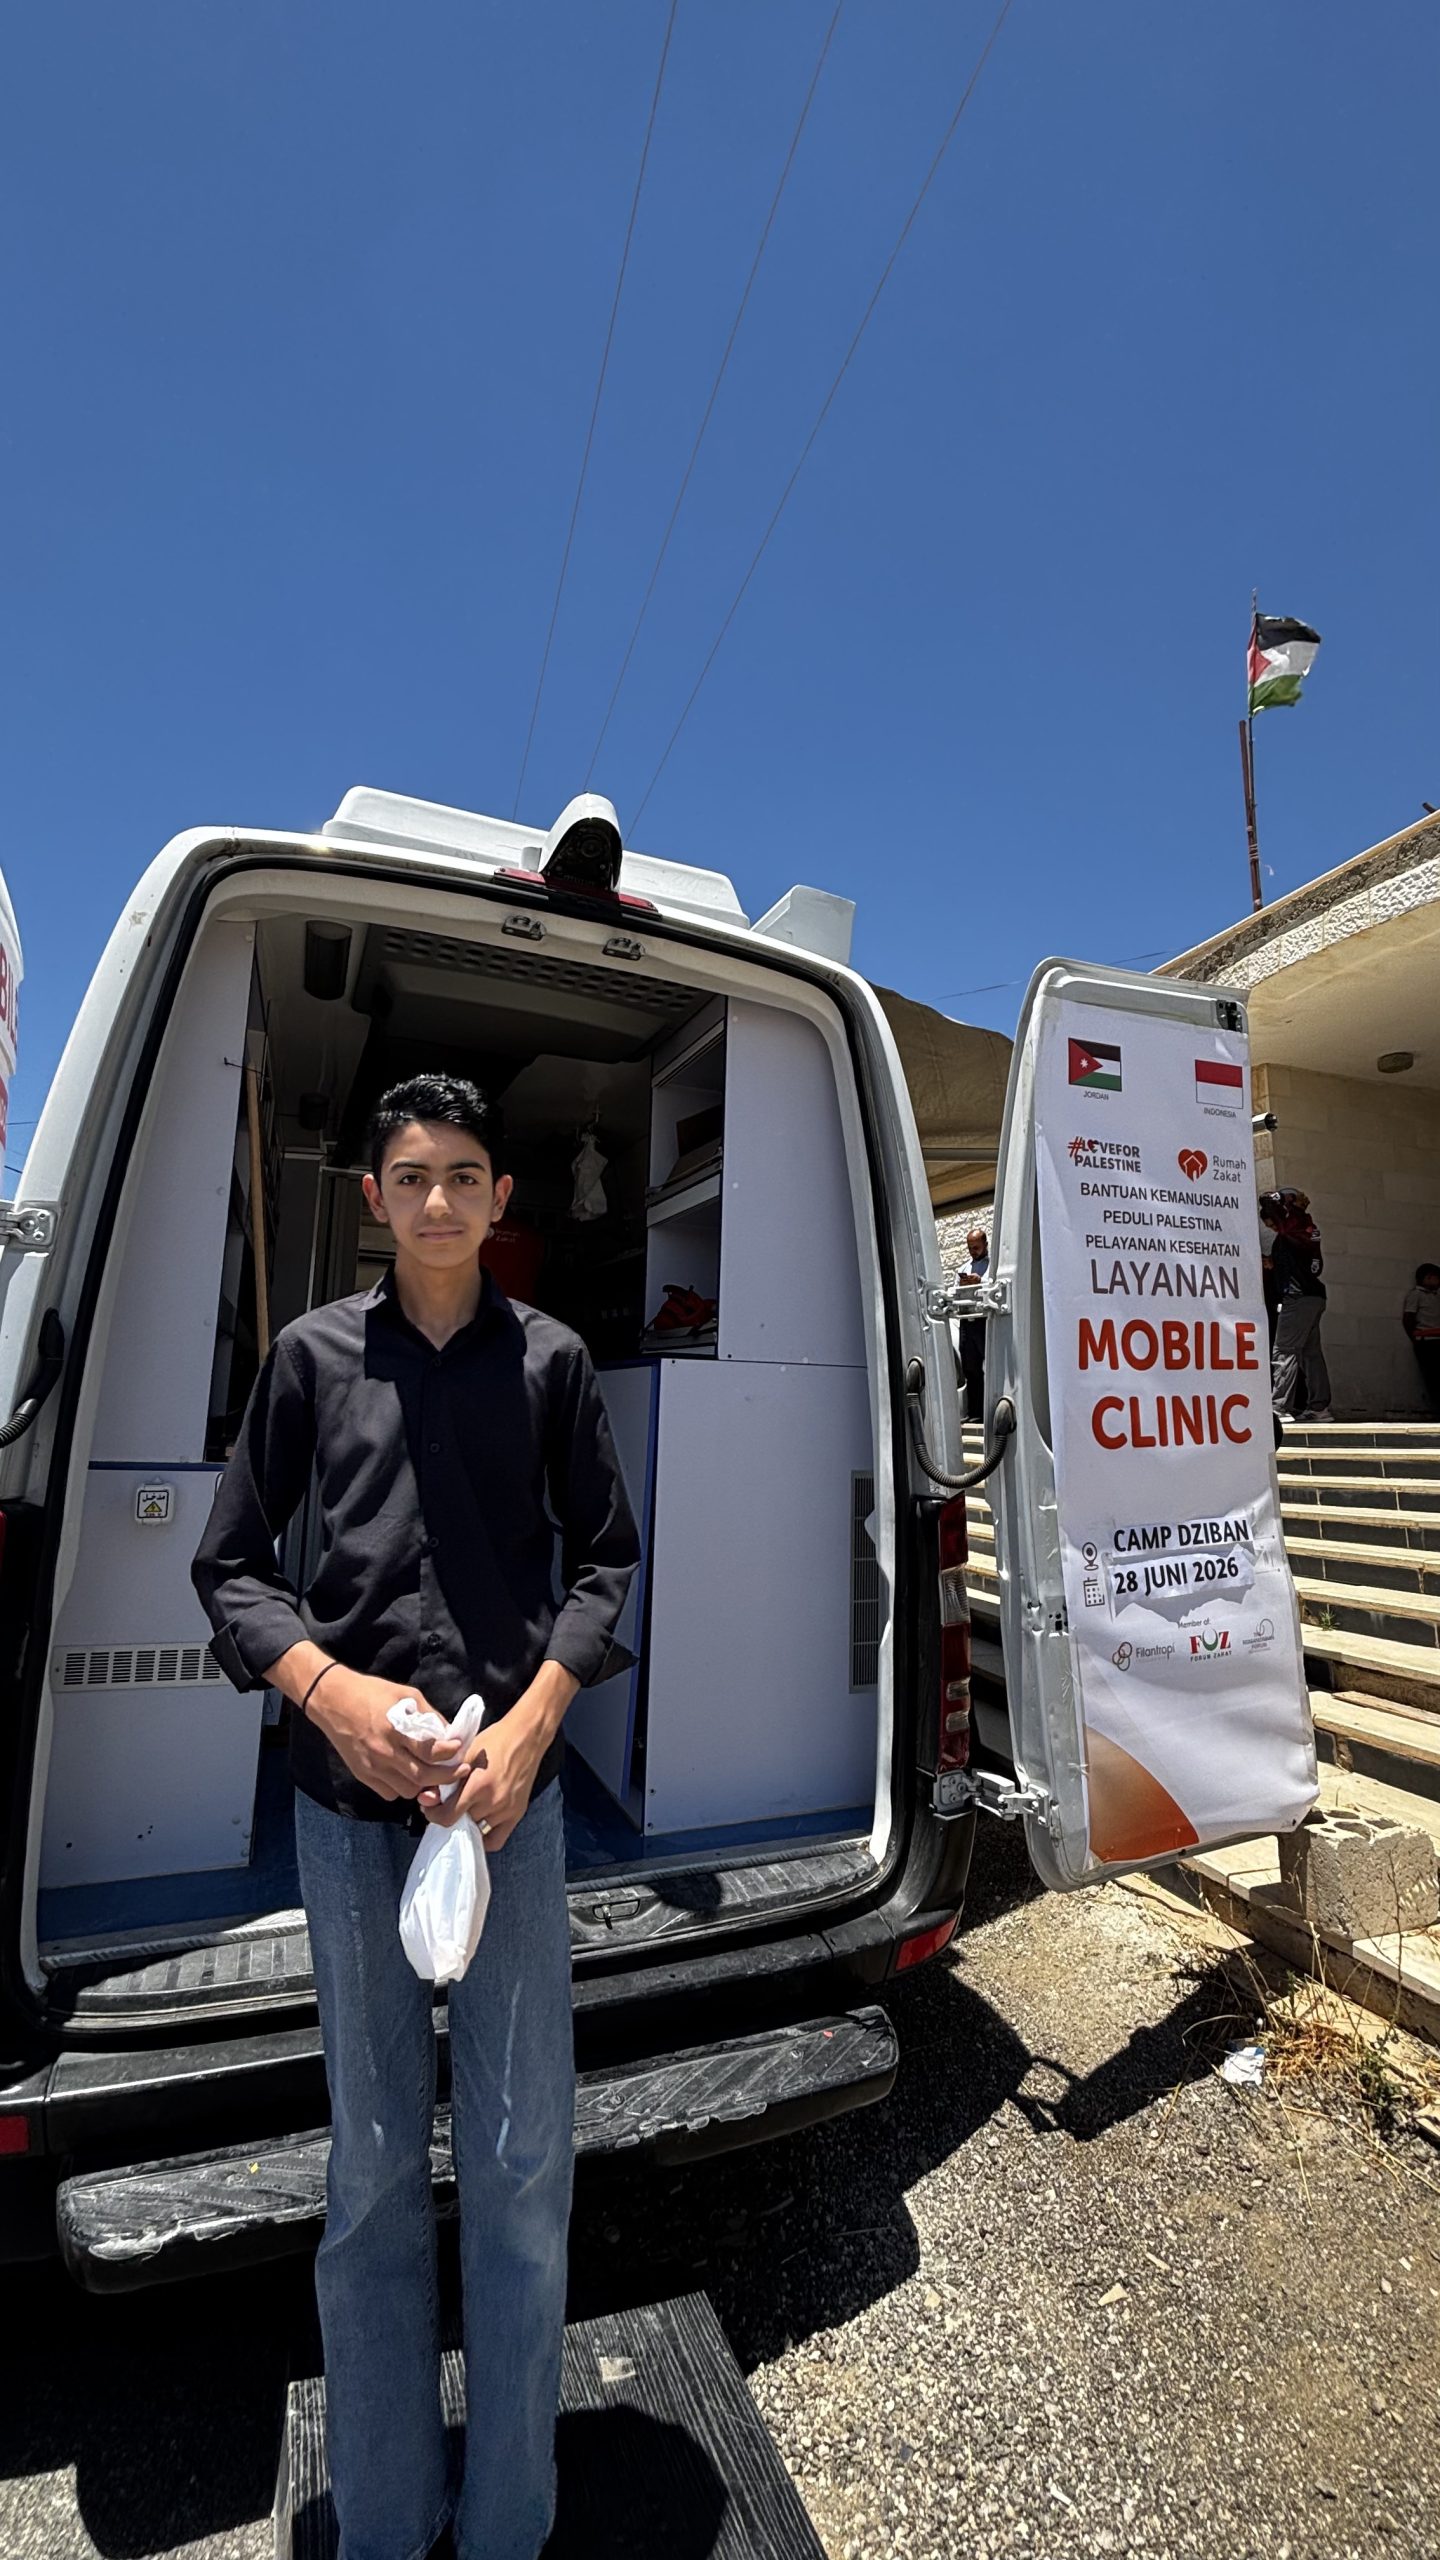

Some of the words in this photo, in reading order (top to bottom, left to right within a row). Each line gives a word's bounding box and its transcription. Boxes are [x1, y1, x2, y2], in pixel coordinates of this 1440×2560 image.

[1083, 1090, 1110, 1100] JORDAN
[1203, 1107, 1237, 1119] INDONESIA
[1074, 1155, 1142, 1173] PALESTINE
[1212, 1155, 1247, 1170] Rumah
[1212, 1169, 1242, 1183] Zakat
[1080, 1182, 1148, 1201] BANTUAN
[1151, 1188, 1239, 1209] KEMANUSIAAN
[1103, 1210, 1153, 1226] PEDULI
[1156, 1214, 1222, 1232] PALESTINA
[1085, 1234, 1166, 1252] PELAYANAN
[1169, 1239, 1240, 1257] KESEHATAN
[1091, 1259, 1240, 1299] LAYANAN
[1078, 1318, 1259, 1371] MOBILE
[1091, 1394, 1252, 1450] CLINIC
[1113, 1526, 1172, 1552] CAMP
[1177, 1519, 1250, 1547] DZIBAN
[1113, 1570, 1138, 1595] 28
[1144, 1562, 1188, 1596] JUNI
[1192, 1557, 1239, 1582] 2026
[1135, 1642, 1176, 1660] Filantropi
